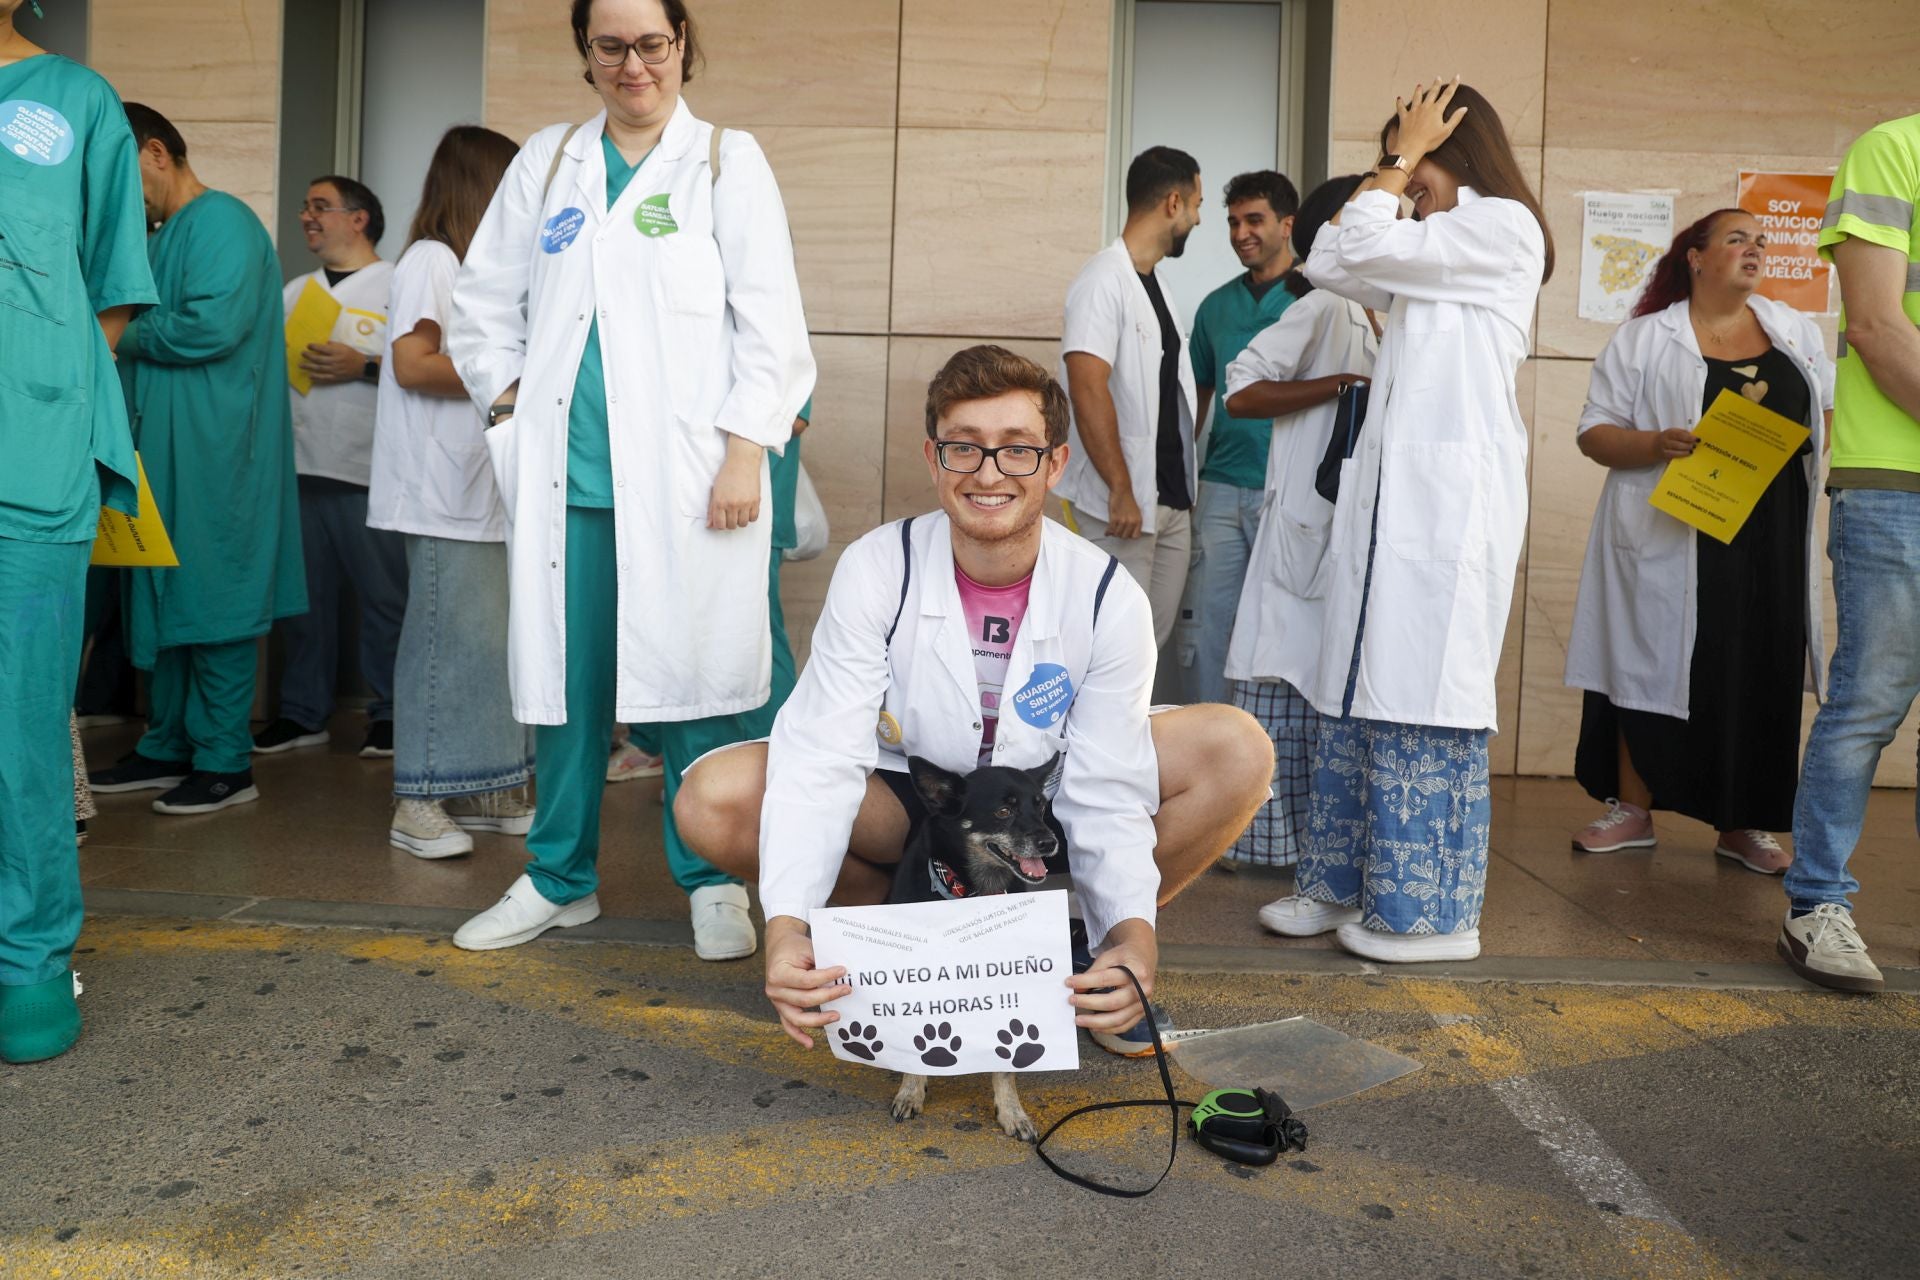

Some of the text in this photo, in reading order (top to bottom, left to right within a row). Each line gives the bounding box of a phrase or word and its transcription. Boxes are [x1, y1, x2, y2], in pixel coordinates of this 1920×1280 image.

[15, 113, 57, 140] COTIZAN
[17, 106, 65, 137] GUARDIAS
[36, 108, 54, 121] MIS
[7, 124, 50, 153] CUENTAN
[12, 118, 53, 146] PERO NO
[1588, 208, 1670, 221] Huelga nacional
[1768, 199, 1801, 213] SOY
[543, 211, 582, 237] GUARDIAS
[1765, 255, 1823, 268] APOYO LA
[1703, 442, 1758, 472] PROFESIÓN DE RIESGO
[1667, 491, 1690, 505] ESTATUTO
[1690, 502, 1708, 514] MARCO
[129, 523, 146, 552] ESTATUTO
[971, 648, 1011, 660] pament
[1015, 671, 1068, 703] GUARDIAS
[1029, 685, 1064, 708] SIN FIN
[1036, 707, 1048, 716] OCT
[1048, 692, 1068, 710] HUELGA
[1007, 904, 1018, 913] ME
[1019, 896, 1036, 907] TIENE
[832, 916, 866, 930] JORNADAS
[867, 924, 902, 938] LABORALES
[903, 933, 921, 943] IGUAL
[842, 930, 913, 952] OTROS TRABAJADORES
[959, 934, 972, 943] QUE
[973, 926, 993, 938] SACAR
[994, 922, 1003, 930] DE
[859, 970, 888, 987] NO
[893, 967, 932, 984] VEO
[937, 966, 950, 982] A
[956, 963, 980, 980] MI
[986, 955, 1054, 978] DUEÑO
[872, 992, 1020, 1017] EN 24 HORAS !!!
